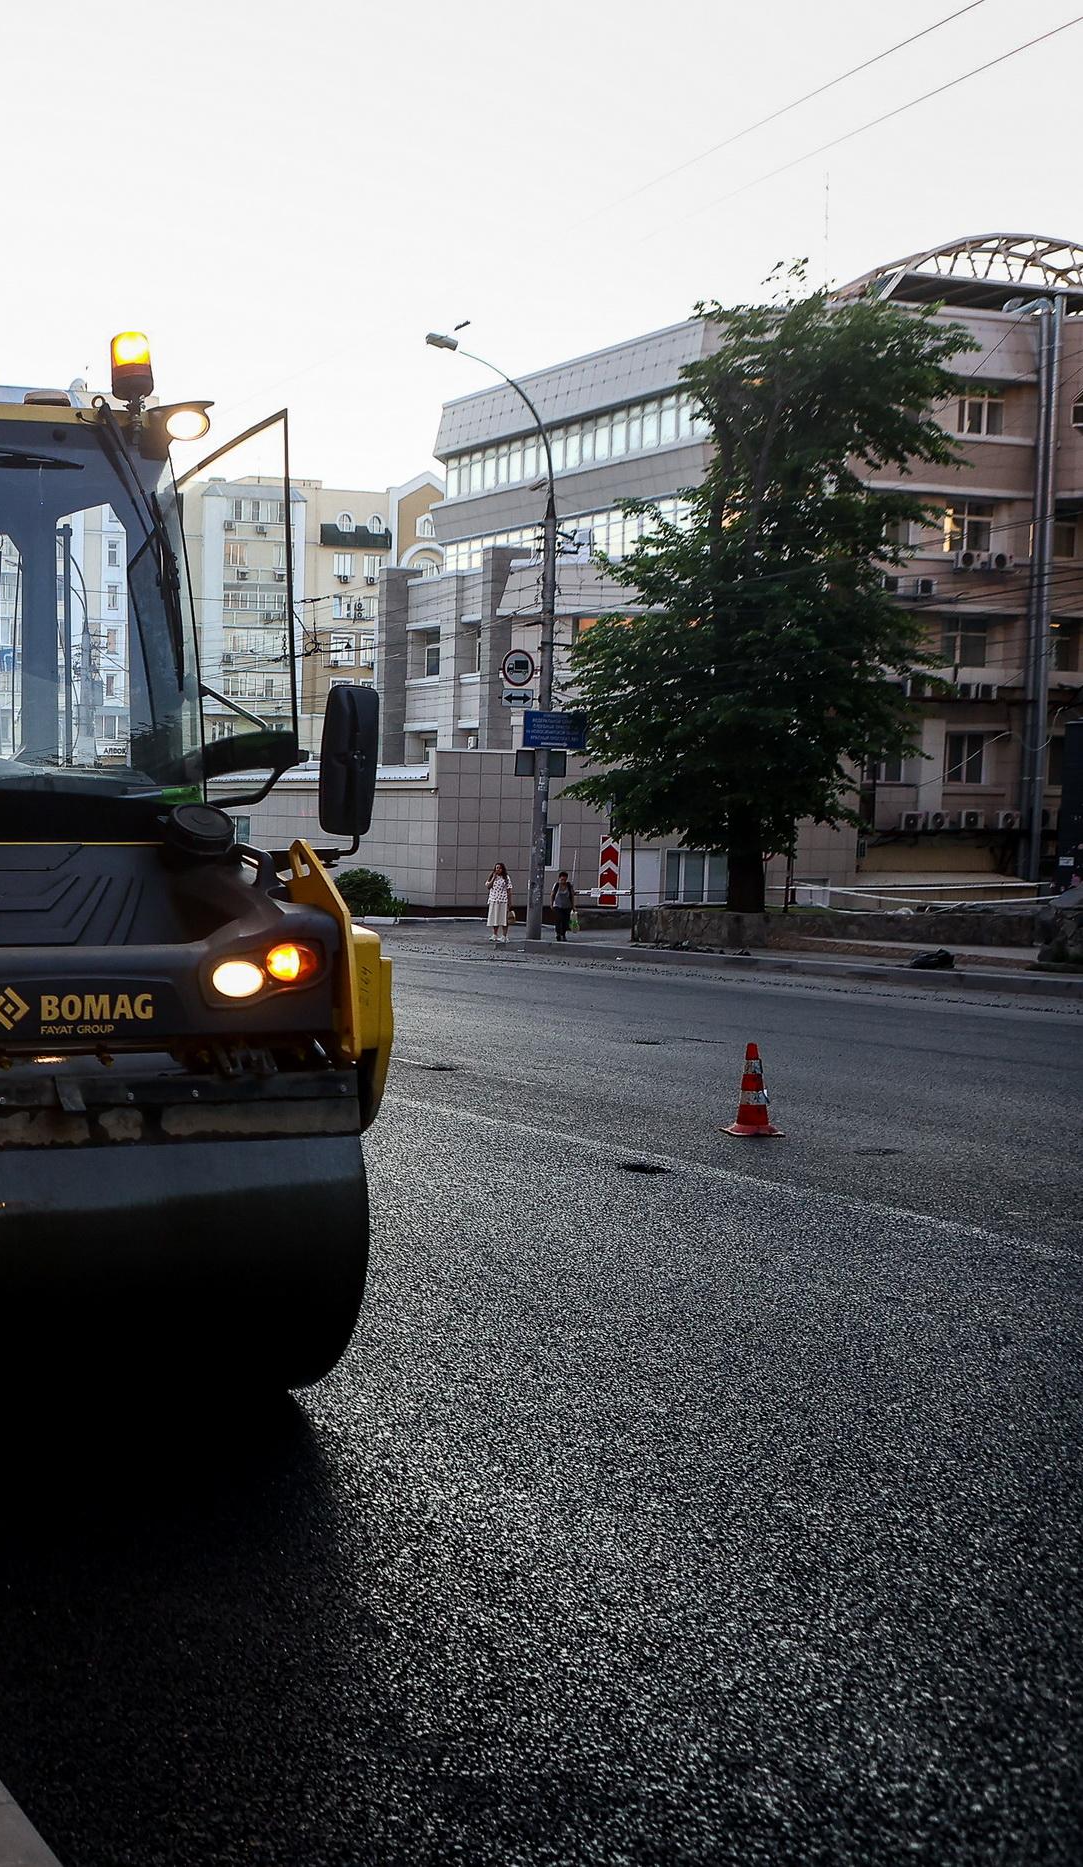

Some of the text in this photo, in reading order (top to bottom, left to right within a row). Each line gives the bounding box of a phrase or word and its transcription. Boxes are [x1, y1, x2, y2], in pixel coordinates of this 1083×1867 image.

[40, 993, 153, 1021] BOMAG
[40, 1024, 115, 1035] FAYAT GROUP
